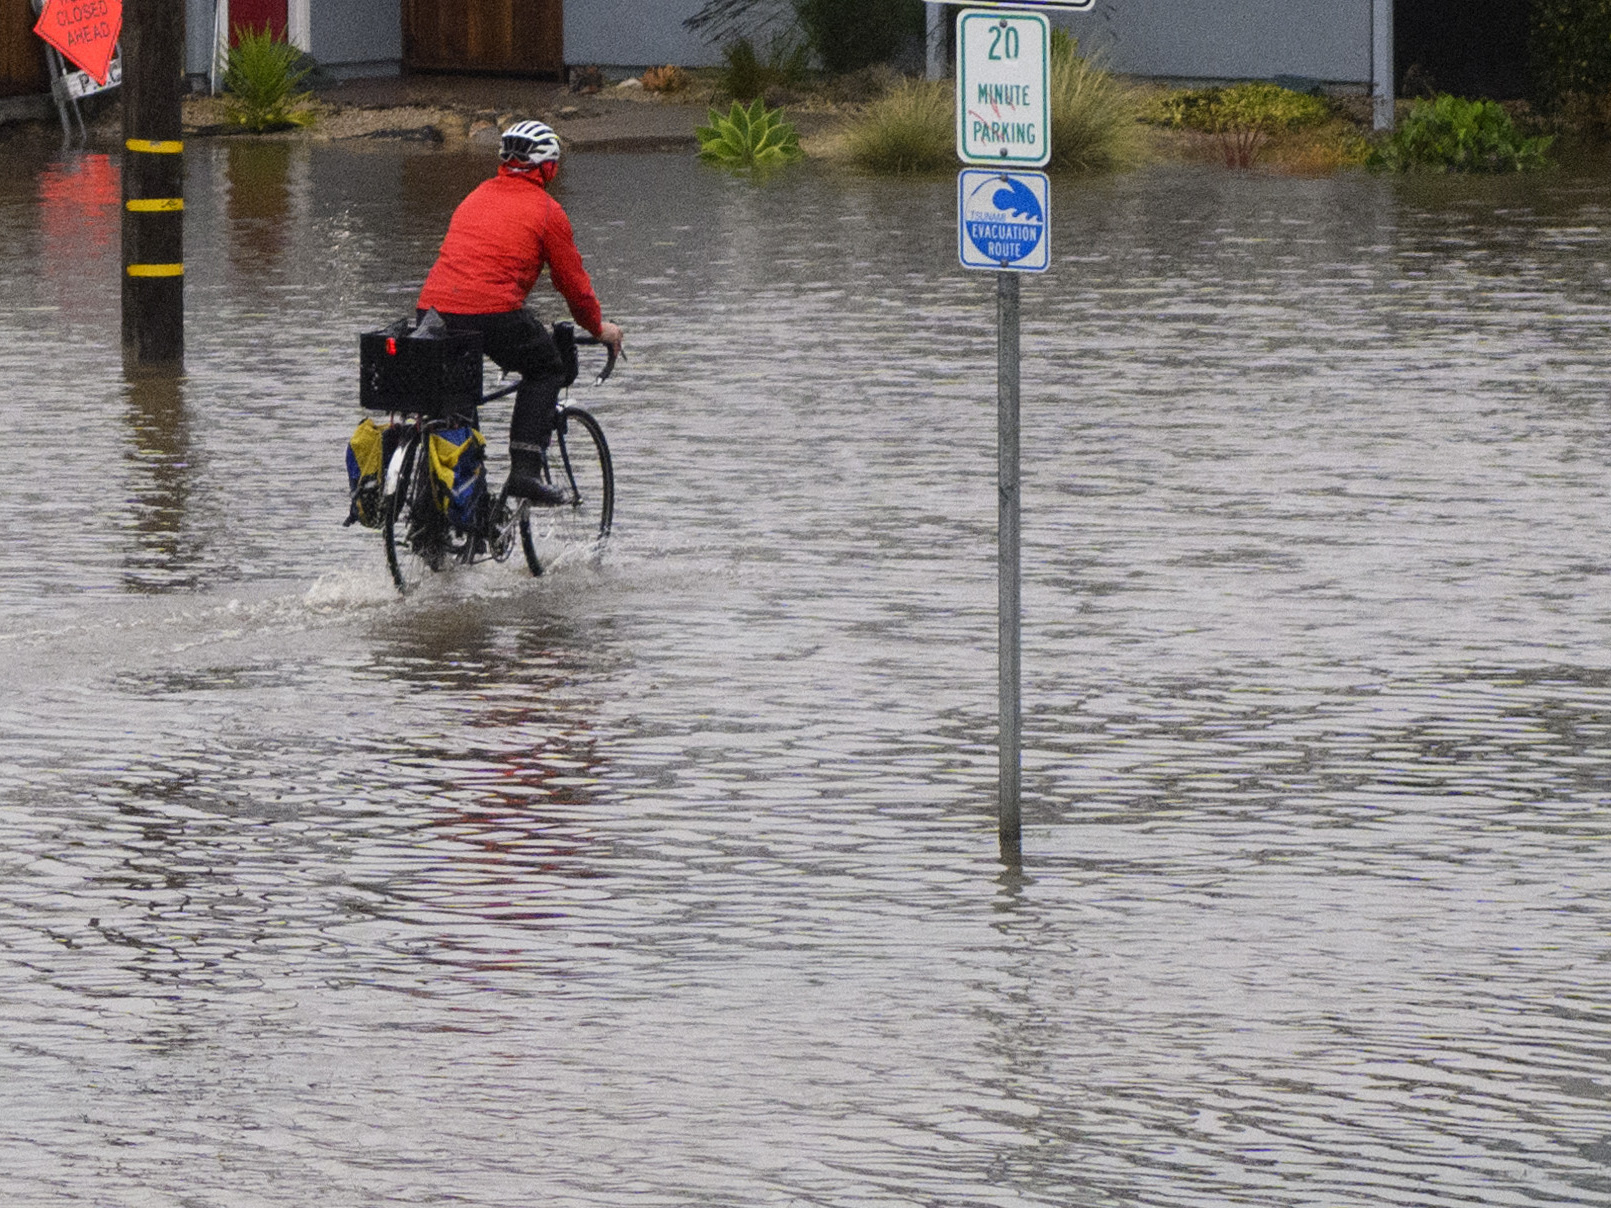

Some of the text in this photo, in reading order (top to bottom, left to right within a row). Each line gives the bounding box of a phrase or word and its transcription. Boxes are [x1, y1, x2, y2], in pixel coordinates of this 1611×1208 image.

[56, 0, 108, 26] CLOSED
[68, 22, 110, 46] AHEAD
[988, 25, 1019, 60] 20
[978, 83, 1031, 106] MINUTE
[973, 121, 1036, 144] PARKING
[972, 223, 1038, 241] EVACUATION
[988, 241, 1021, 258] ROUTE
